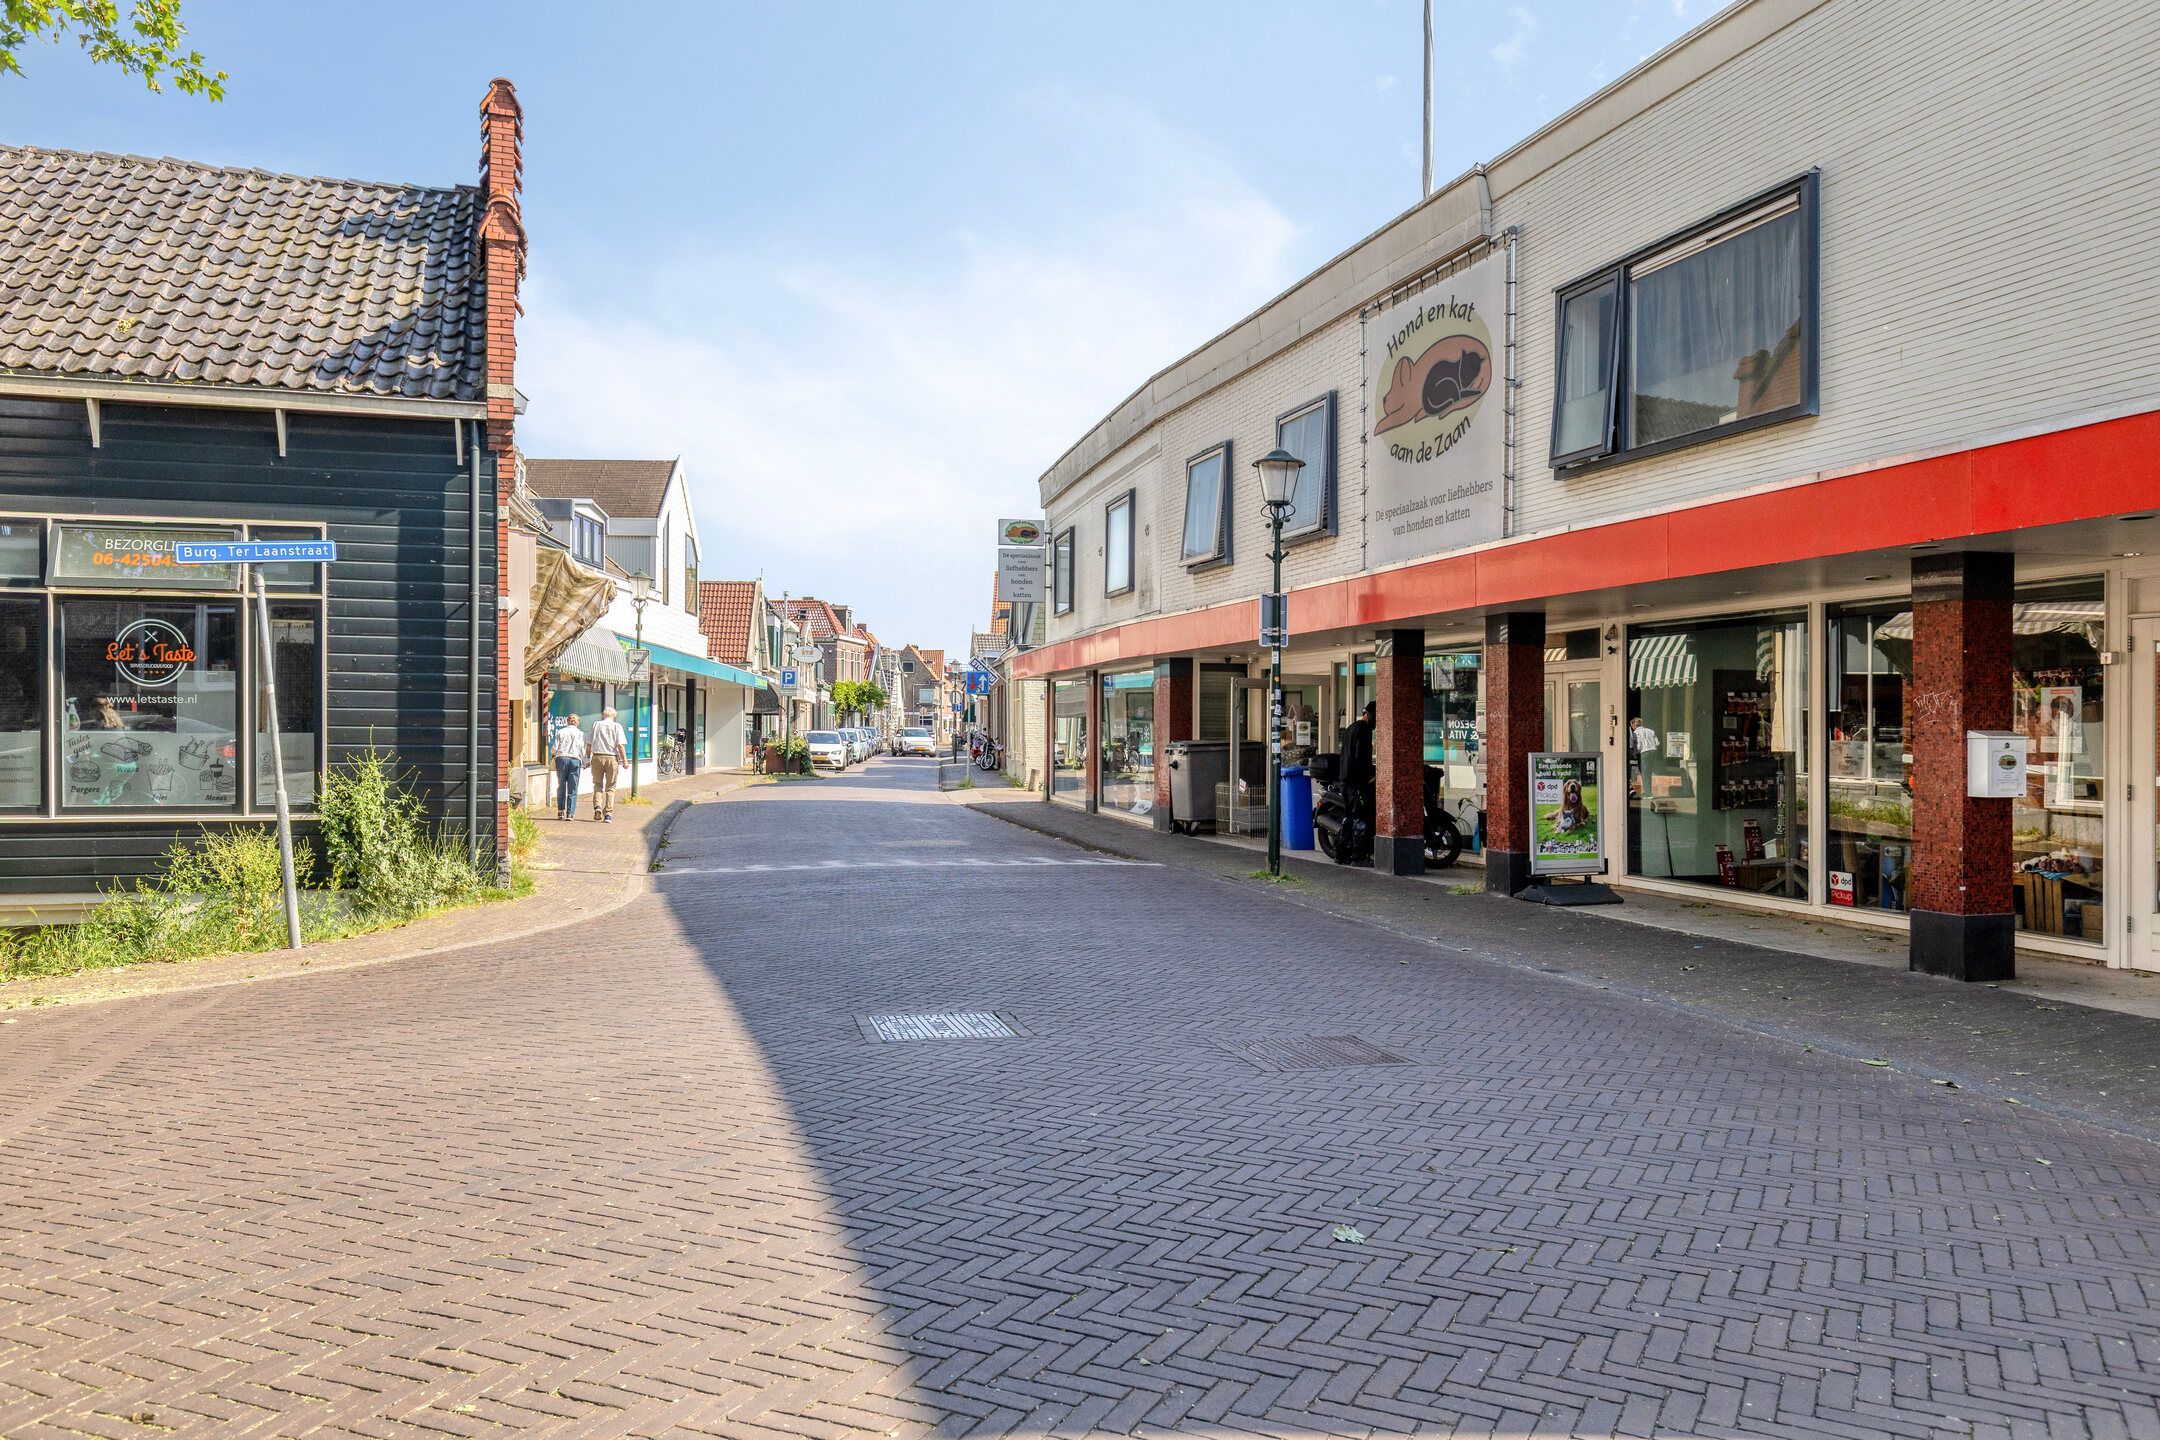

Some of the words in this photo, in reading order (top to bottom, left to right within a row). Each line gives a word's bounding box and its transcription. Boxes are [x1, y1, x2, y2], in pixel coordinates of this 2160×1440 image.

[1386, 306, 1424, 359] Hond
[1427, 302, 1446, 323] en
[1449, 294, 1475, 323] kat
[1390, 442, 1414, 464] aan
[1415, 441, 1432, 464] de
[1434, 415, 1471, 459] Zaan
[1385, 496, 1429, 521] speciaalzaak
[1429, 492, 1447, 507] voor
[1447, 480, 1494, 502] liefhebbers
[1393, 525, 1405, 536] van
[1406, 516, 1434, 533] honden
[1434, 515, 1444, 526] en
[1445, 508, 1471, 523] katten
[184, 547, 222, 560] Burg.
[228, 546, 250, 557] Ter
[254, 545, 329, 557] Laanstraat
[105, 641, 151, 661] Let's
[153, 643, 198, 662] Taste
[784, 672, 793, 684] P
[106, 694, 198, 704] www.letstaste.nl
[70, 785, 101, 795] Burgers
[1840, 877, 1852, 886] dpd
[1831, 890, 1853, 902] Pickup
